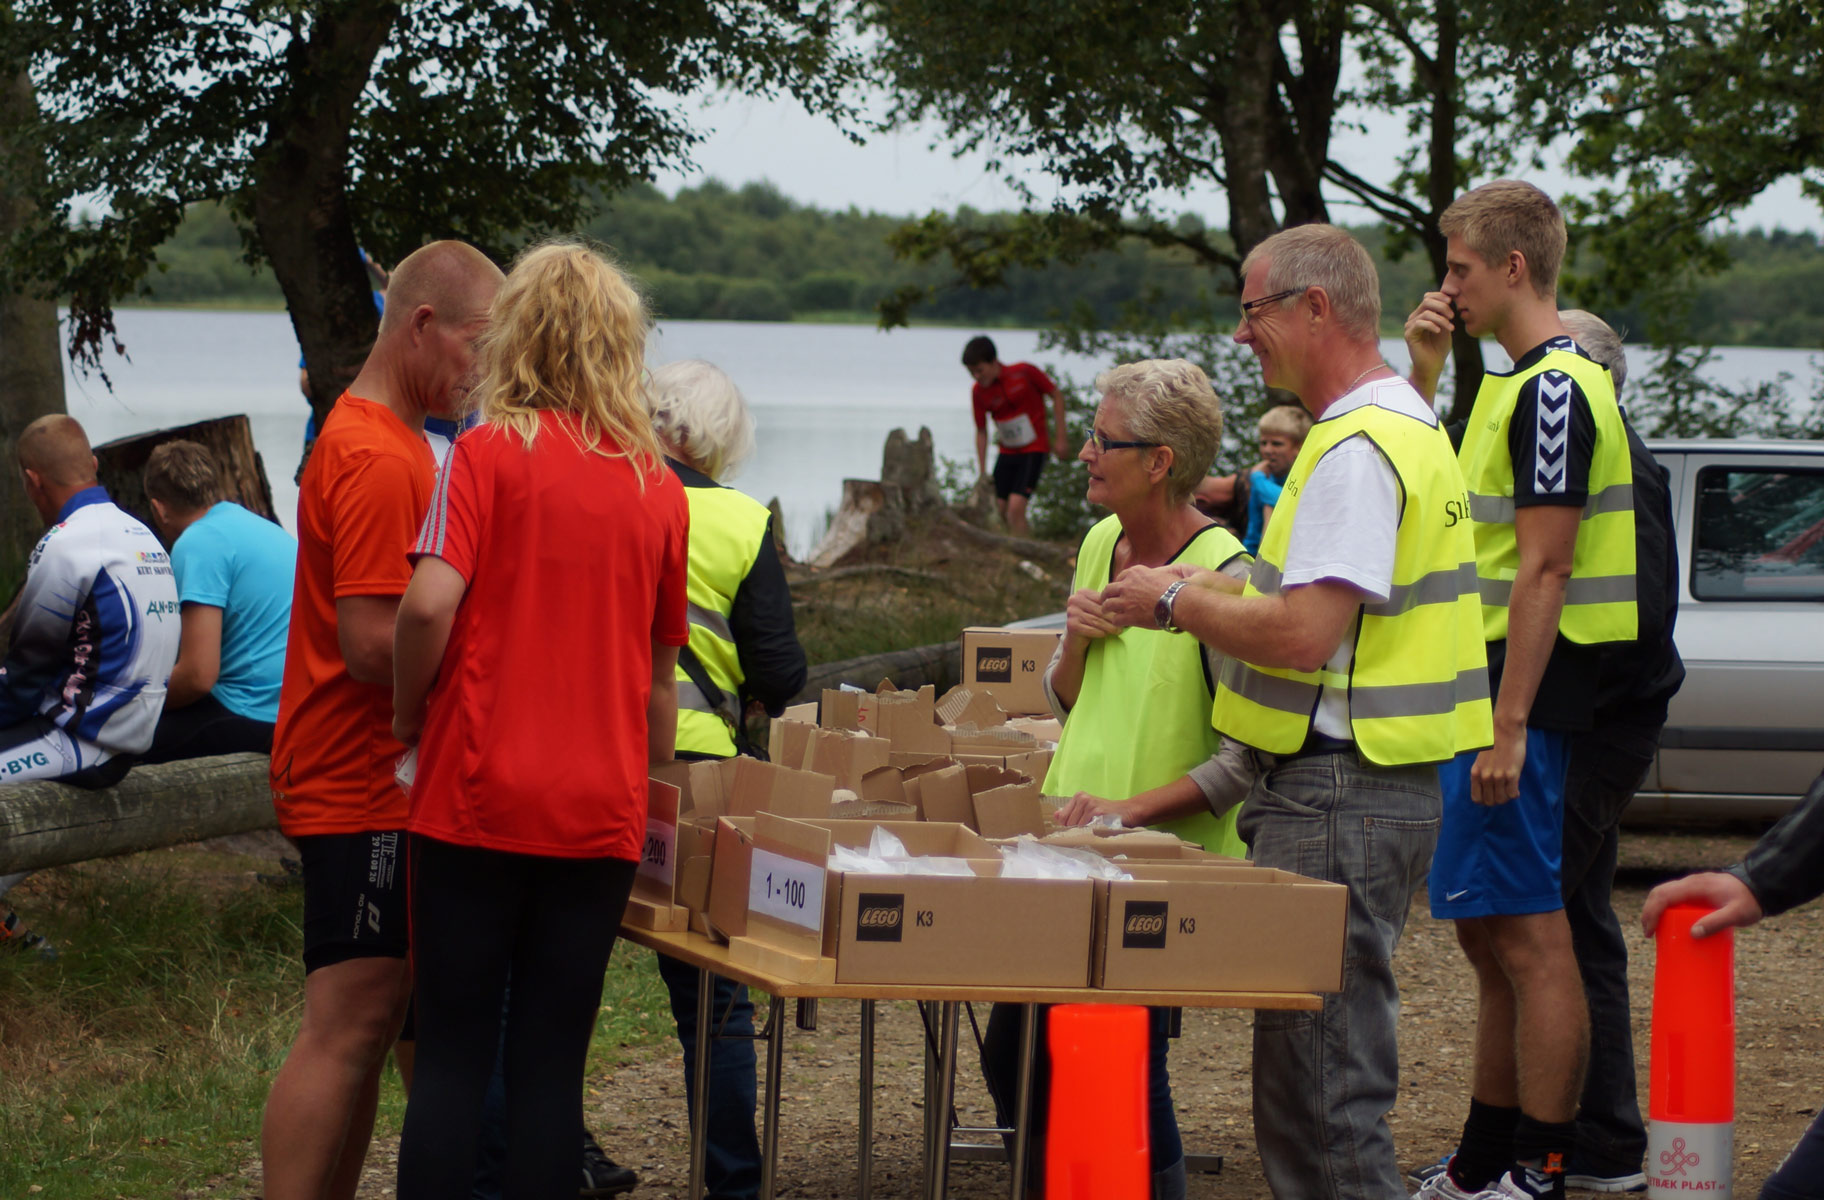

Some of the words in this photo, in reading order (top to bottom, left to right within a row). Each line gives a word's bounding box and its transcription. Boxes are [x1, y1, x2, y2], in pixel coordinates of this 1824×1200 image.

[978, 658, 1009, 672] LEGO
[1021, 659, 1036, 673] K3
[371, 836, 380, 847] 29
[370, 848, 379, 858] 13
[647, 836, 666, 867] 200
[368, 871, 377, 882] 20
[766, 872, 773, 899] 1
[784, 878, 806, 909] 100
[353, 909, 363, 939] TOUCH
[861, 908, 899, 926] LEGO
[916, 910, 934, 927] K3
[1127, 915, 1163, 933] LEGO
[1179, 918, 1196, 934] K3
[1681, 1181, 1717, 1191] PLAST
